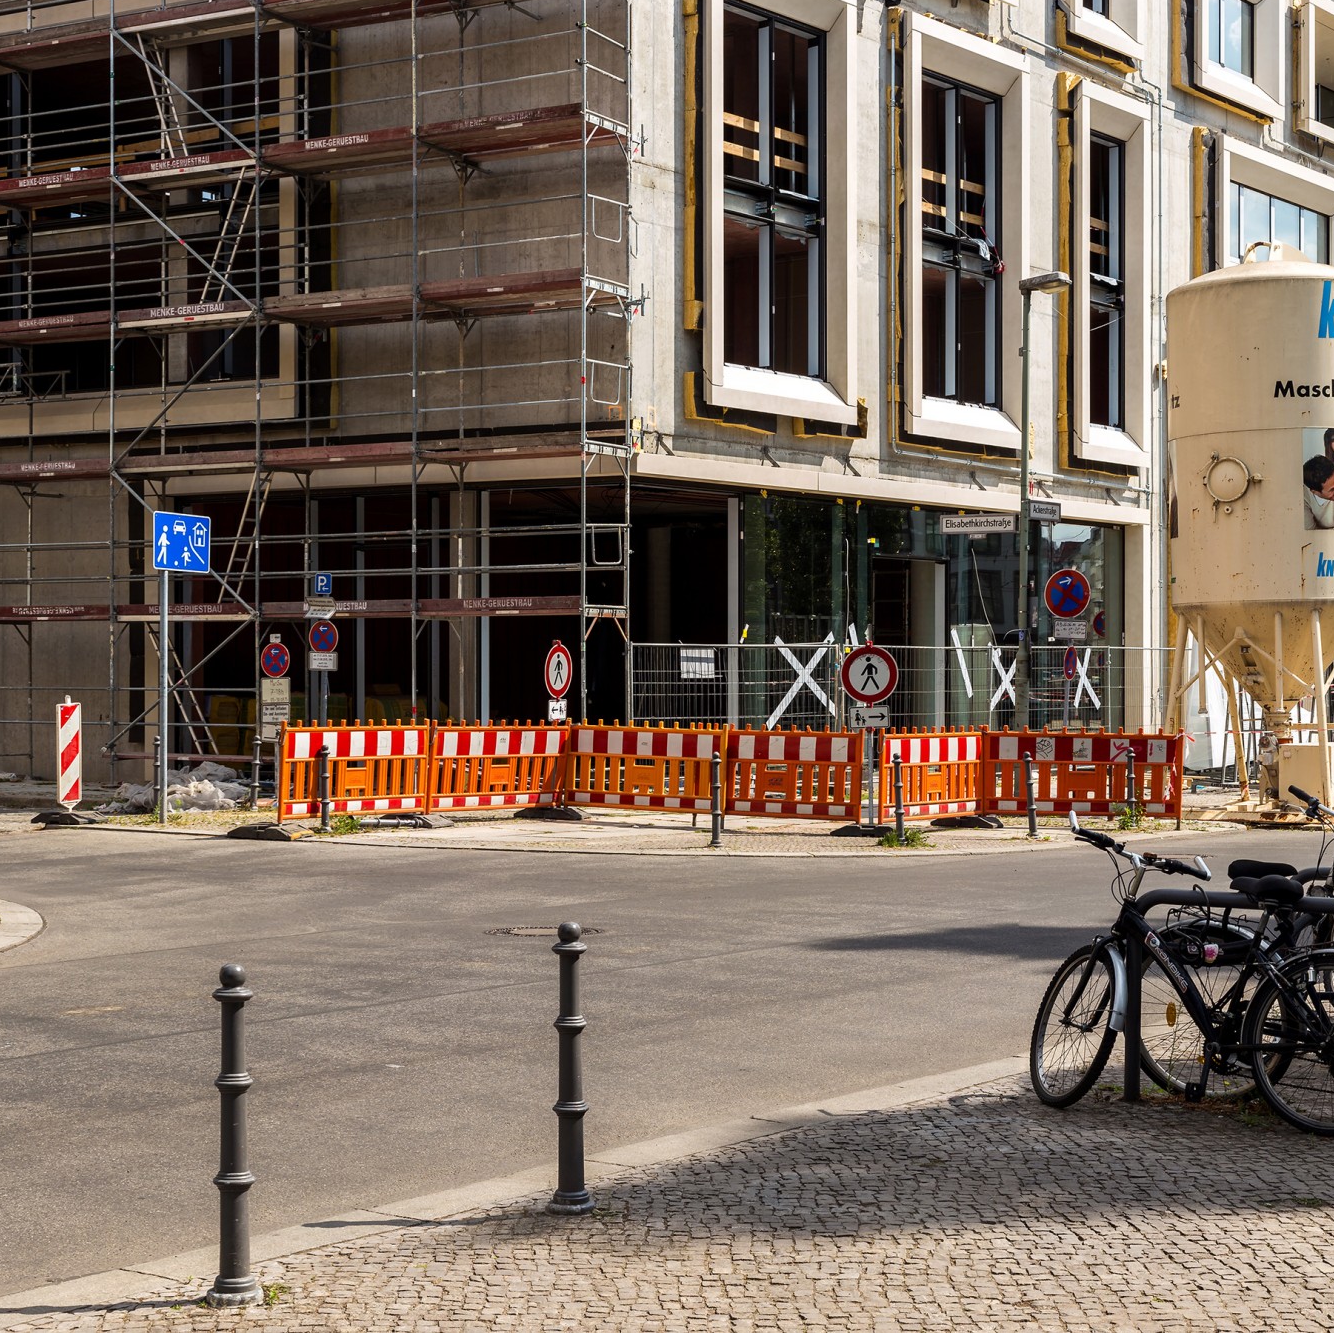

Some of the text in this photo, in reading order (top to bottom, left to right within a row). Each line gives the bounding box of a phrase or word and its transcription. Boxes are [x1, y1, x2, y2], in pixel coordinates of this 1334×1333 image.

[304, 134, 369, 150] MENKE-GERUESTBAU
[150, 155, 210, 170] MENKE-GERUESTBAU
[150, 304, 224, 318] MENKE-GERUESTBAU
[18, 314, 74, 328] MENKE-GERUESTBAU
[20, 461, 76, 471] MENKE-GERUESTBAU
[1032, 504, 1057, 517] Ackerstraße
[945, 517, 1012, 529] Elisabethkirchstraße
[318, 575, 327, 592] P
[463, 597, 533, 609] MENKE-GERUESTBAU
